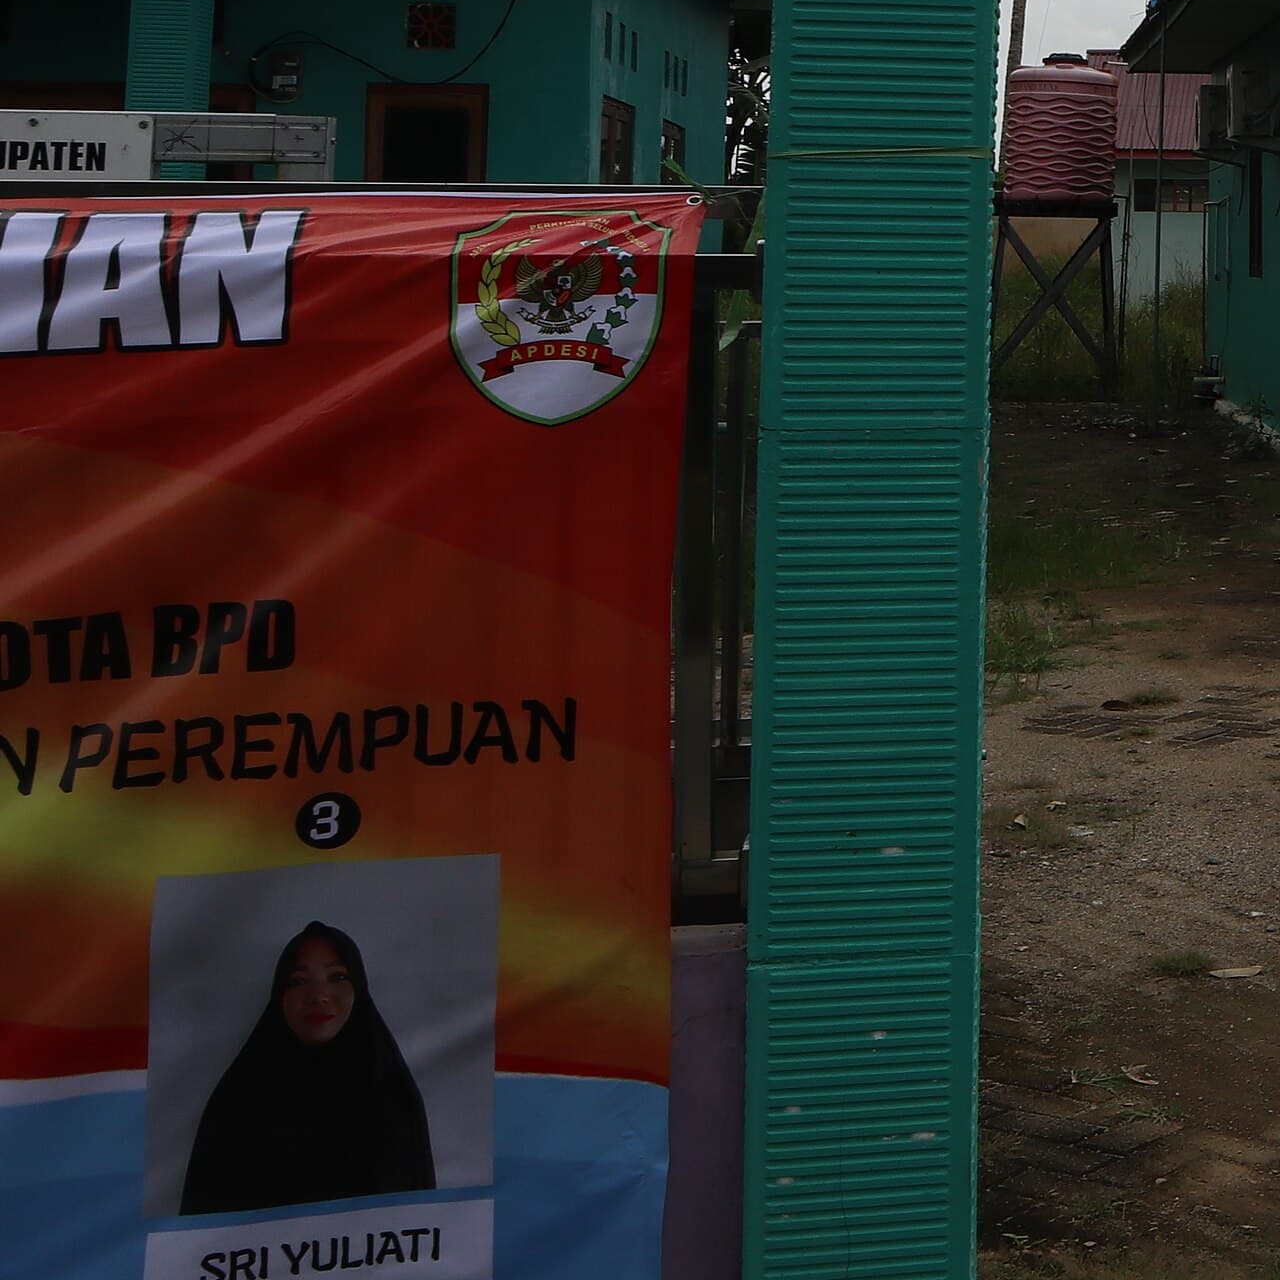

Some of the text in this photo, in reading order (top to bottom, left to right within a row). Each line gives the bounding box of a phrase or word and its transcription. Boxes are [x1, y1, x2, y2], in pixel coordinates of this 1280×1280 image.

[507, 343, 601, 363] APDESI
[151, 599, 297, 678] BPD
[60, 697, 577, 793] PEREMPUAN
[309, 800, 341, 841] 3
[200, 1227, 441, 1280] SRI YULIATI
